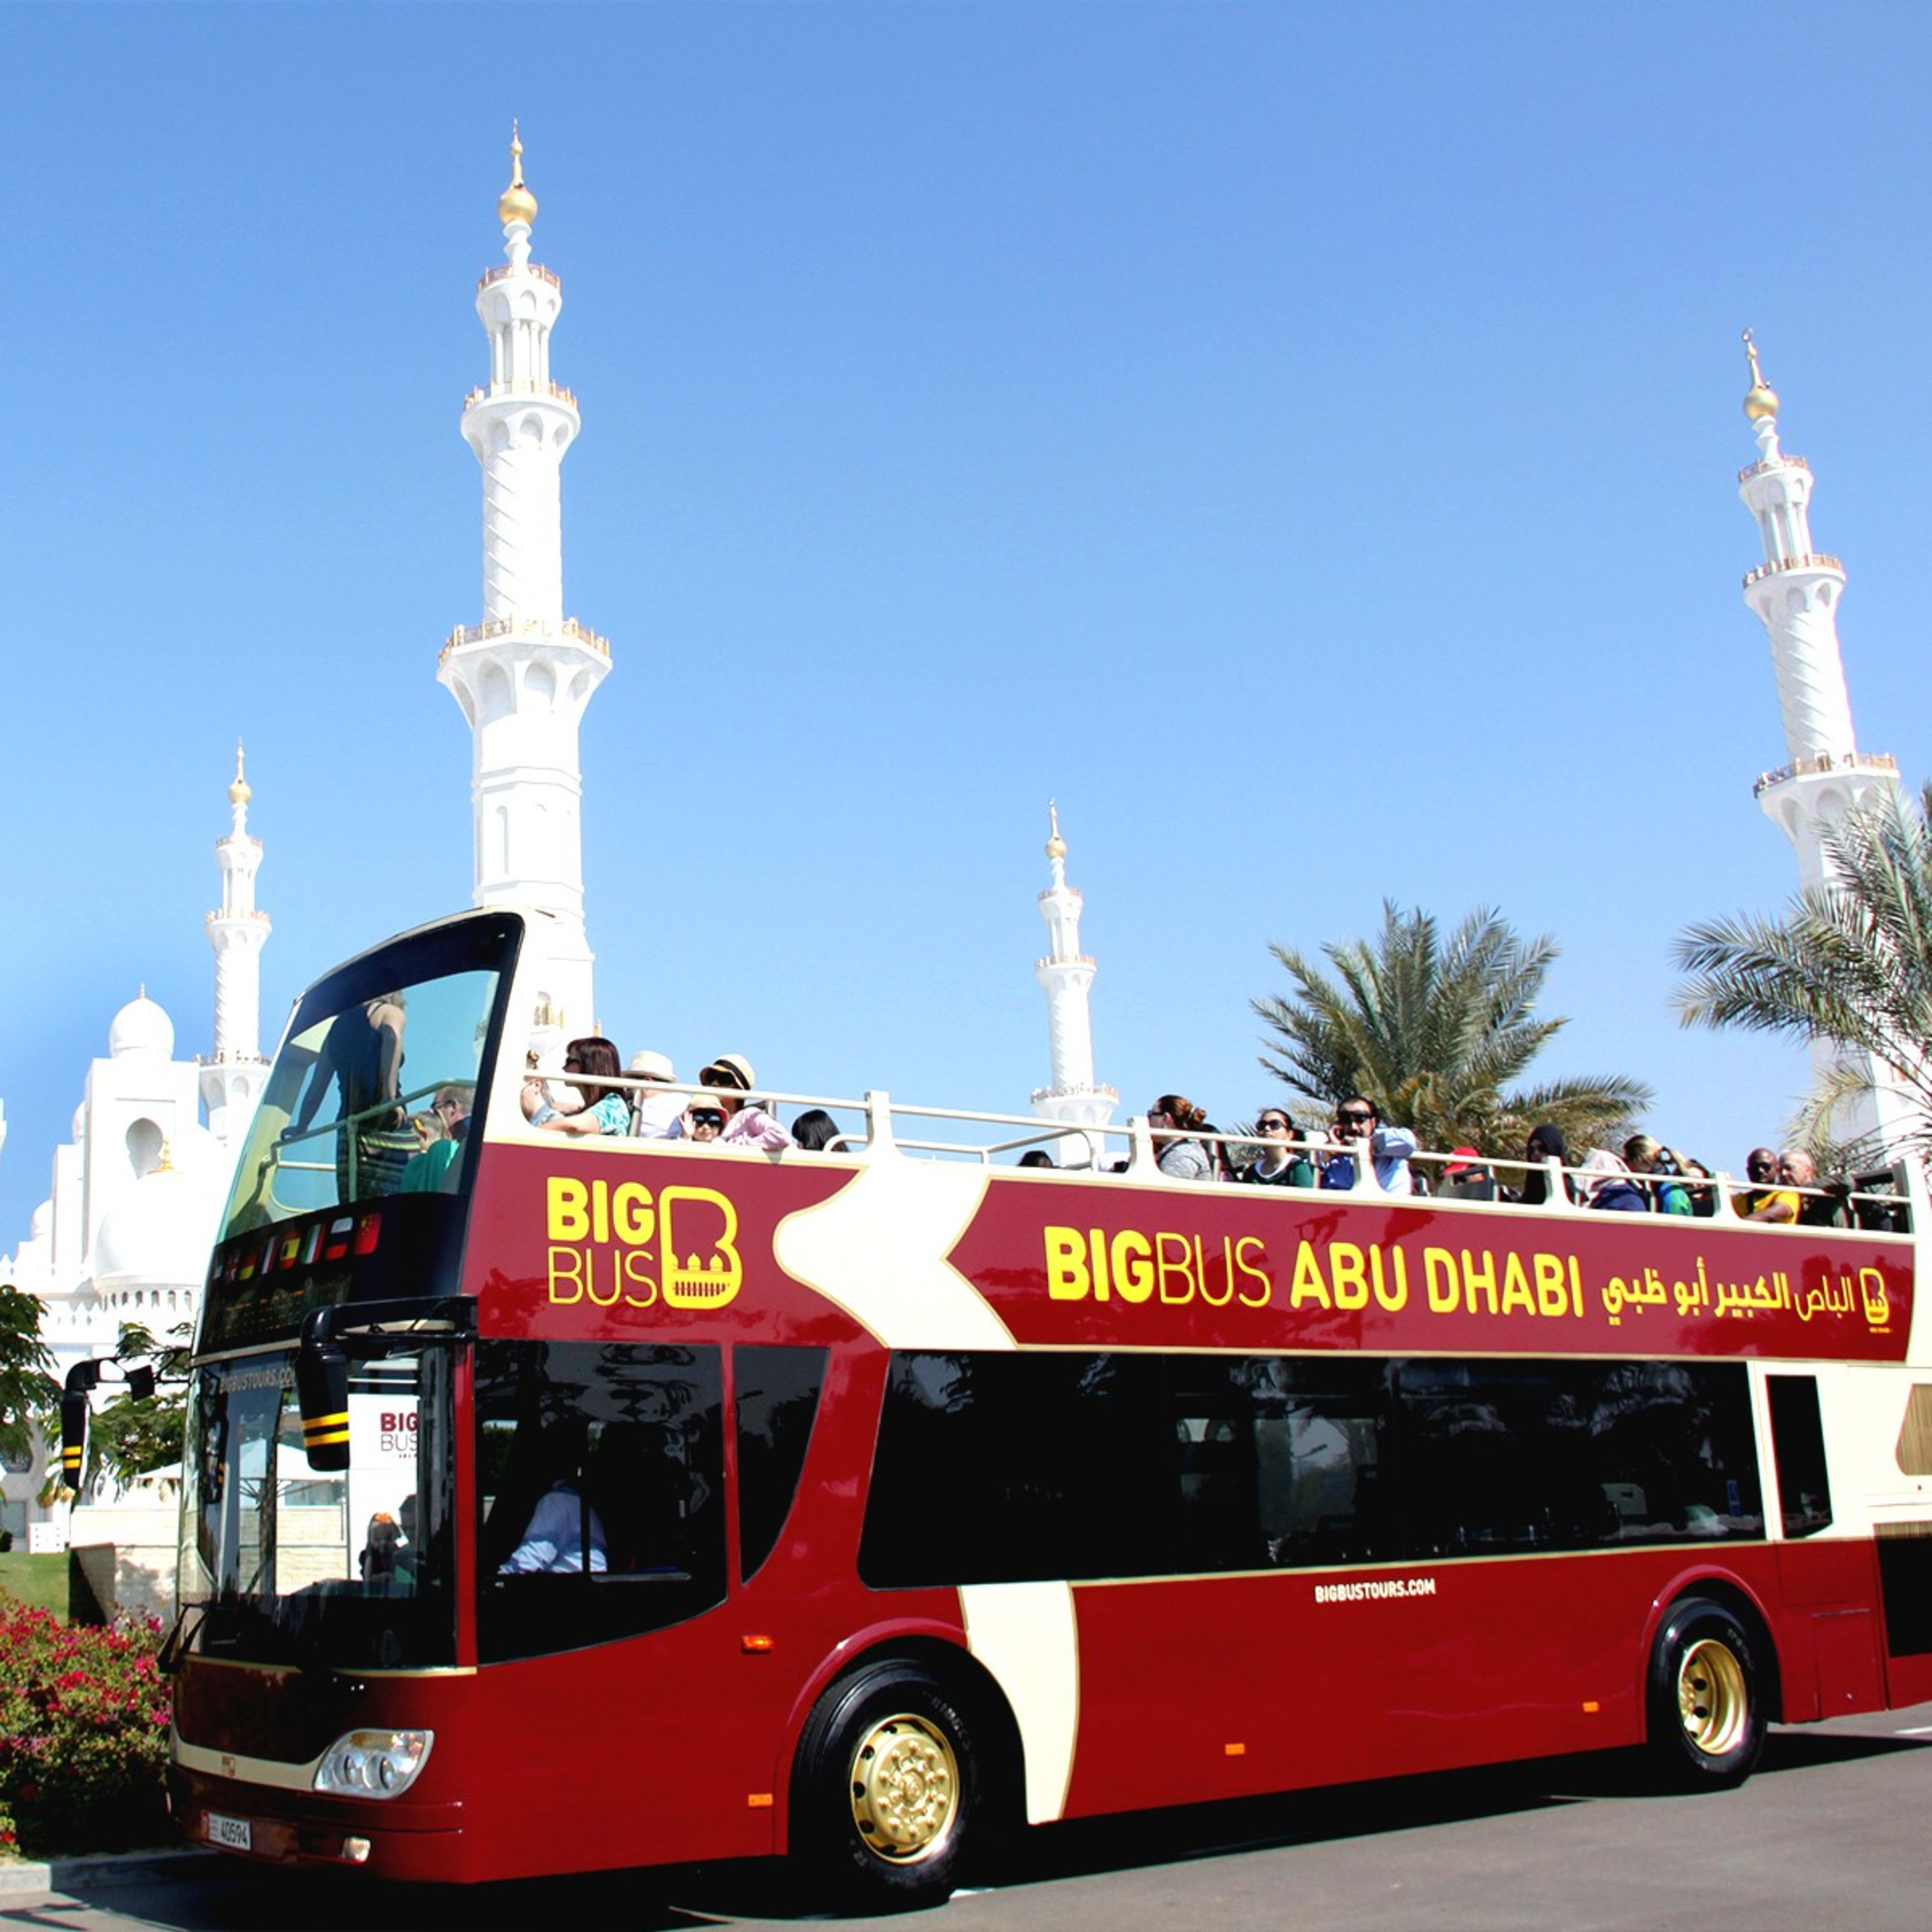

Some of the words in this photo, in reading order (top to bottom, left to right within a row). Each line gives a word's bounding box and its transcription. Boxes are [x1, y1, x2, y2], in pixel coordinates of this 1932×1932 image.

[546, 1176, 655, 1246] BIG
[547, 1245, 658, 1308] BUS
[1289, 1240, 1408, 1312] ABU
[1423, 1246, 1584, 1318] DHABI
[1601, 1267, 1668, 1326] ظبي
[1673, 1255, 1710, 1317] أبو
[1713, 1271, 1792, 1318] الكبير
[1794, 1275, 1856, 1322] الباص
[380, 1411, 418, 1432] BIG
[380, 1433, 418, 1452] BUS
[1314, 1577, 1436, 1603] BIGBUSTOURS.COM
[220, 1820, 248, 1847] 40594
